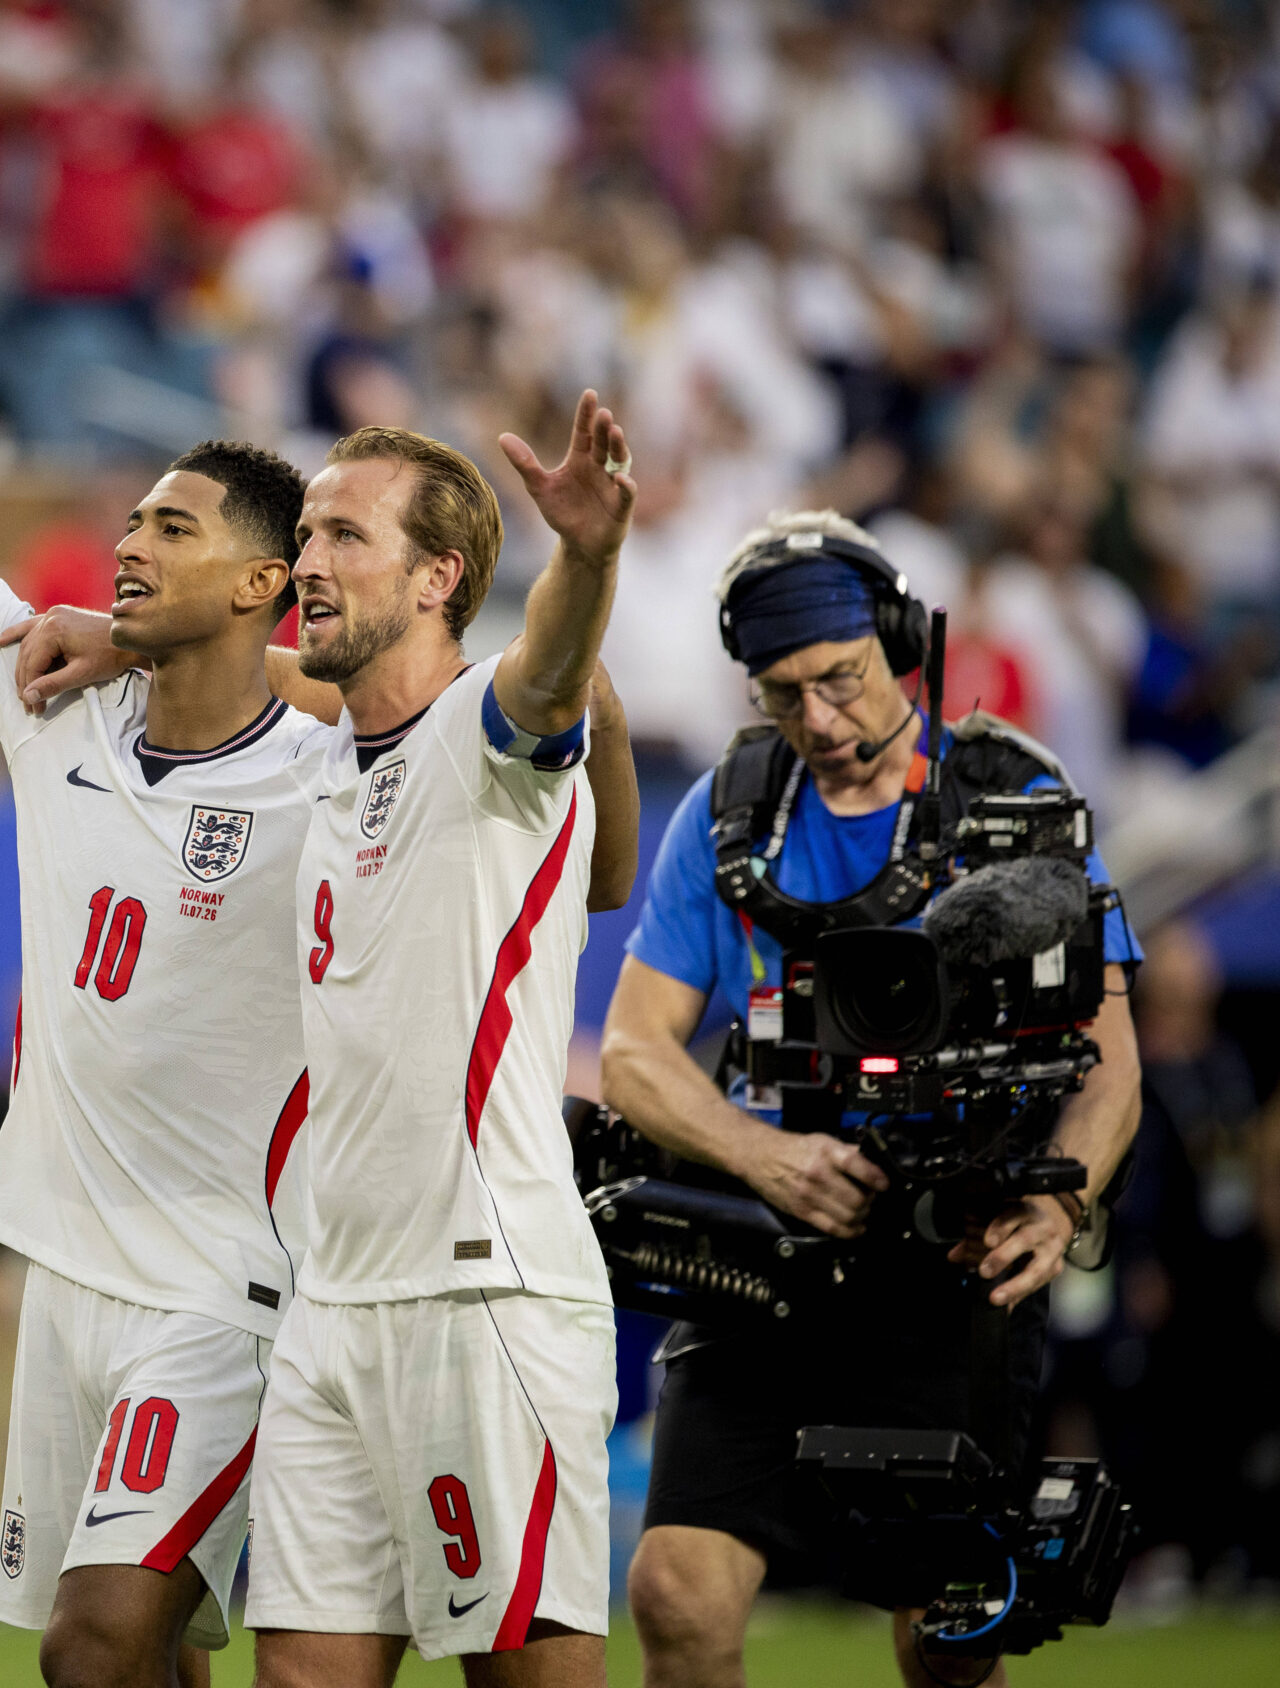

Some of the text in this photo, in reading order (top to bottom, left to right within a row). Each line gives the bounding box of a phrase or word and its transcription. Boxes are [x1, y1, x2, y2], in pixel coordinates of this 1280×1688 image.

[179, 886, 225, 906] NORWAY
[356, 844, 388, 863] NORWAY
[74, 885, 148, 1002] 10
[179, 903, 217, 921] 11.07.26
[308, 880, 335, 985] 9
[94, 1396, 180, 1494] 10
[427, 1473, 482, 1579] 9
